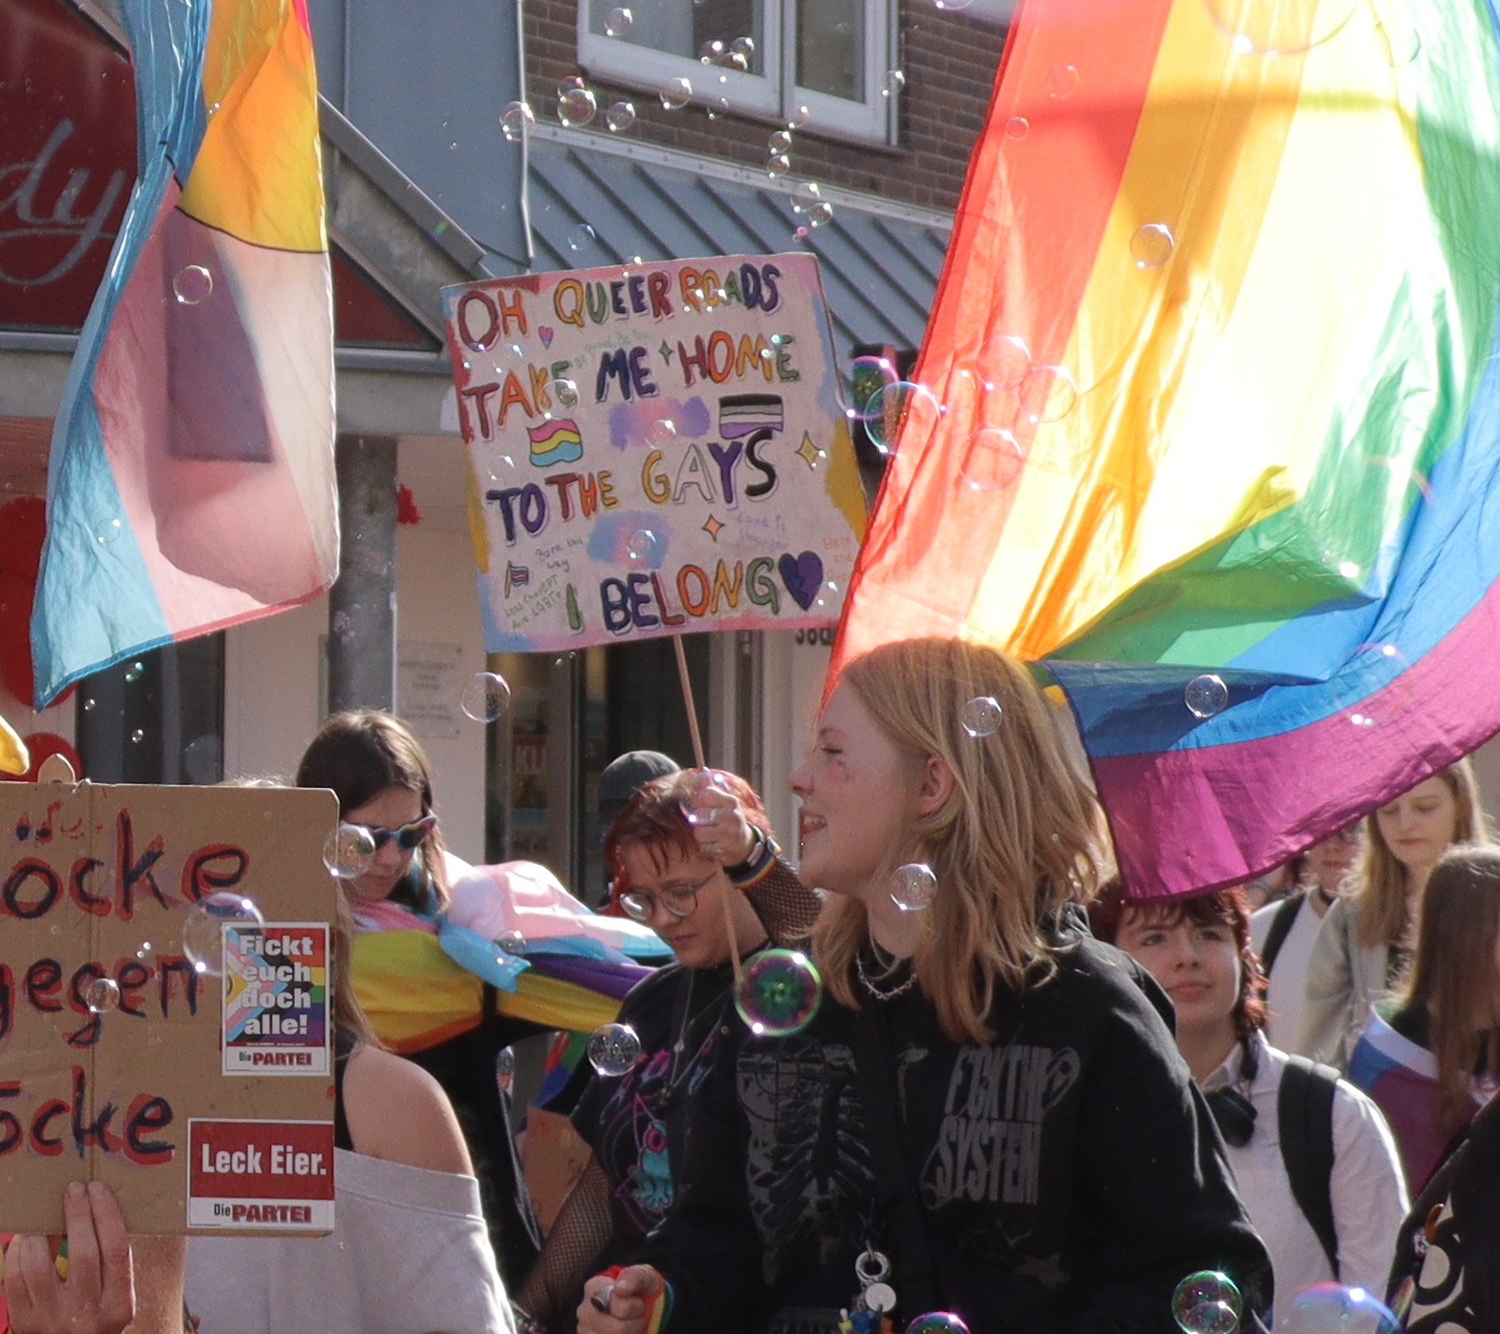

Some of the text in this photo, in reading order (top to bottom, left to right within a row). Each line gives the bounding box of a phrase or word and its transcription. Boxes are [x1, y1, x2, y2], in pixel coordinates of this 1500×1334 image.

[458, 289, 529, 350] OH
[554, 271, 673, 328] QUEER
[679, 263, 782, 314] ROADS
[462, 360, 578, 440] TAKE
[596, 346, 658, 403] ME
[678, 331, 800, 385] HOME
[487, 430, 780, 545] TO THE GAYS
[565, 558, 782, 635] I BELONG
[240, 935, 312, 956] Fickt
[242, 964, 310, 983] euch
[241, 989, 311, 1009] doch
[244, 1015, 308, 1035] alle!
[239, 1051, 312, 1065] Die PARTEI
[202, 1144, 328, 1175] Leck Eier.
[936, 1115, 1041, 1205] SYSTEM
[213, 1203, 312, 1223] Die PARTEI
